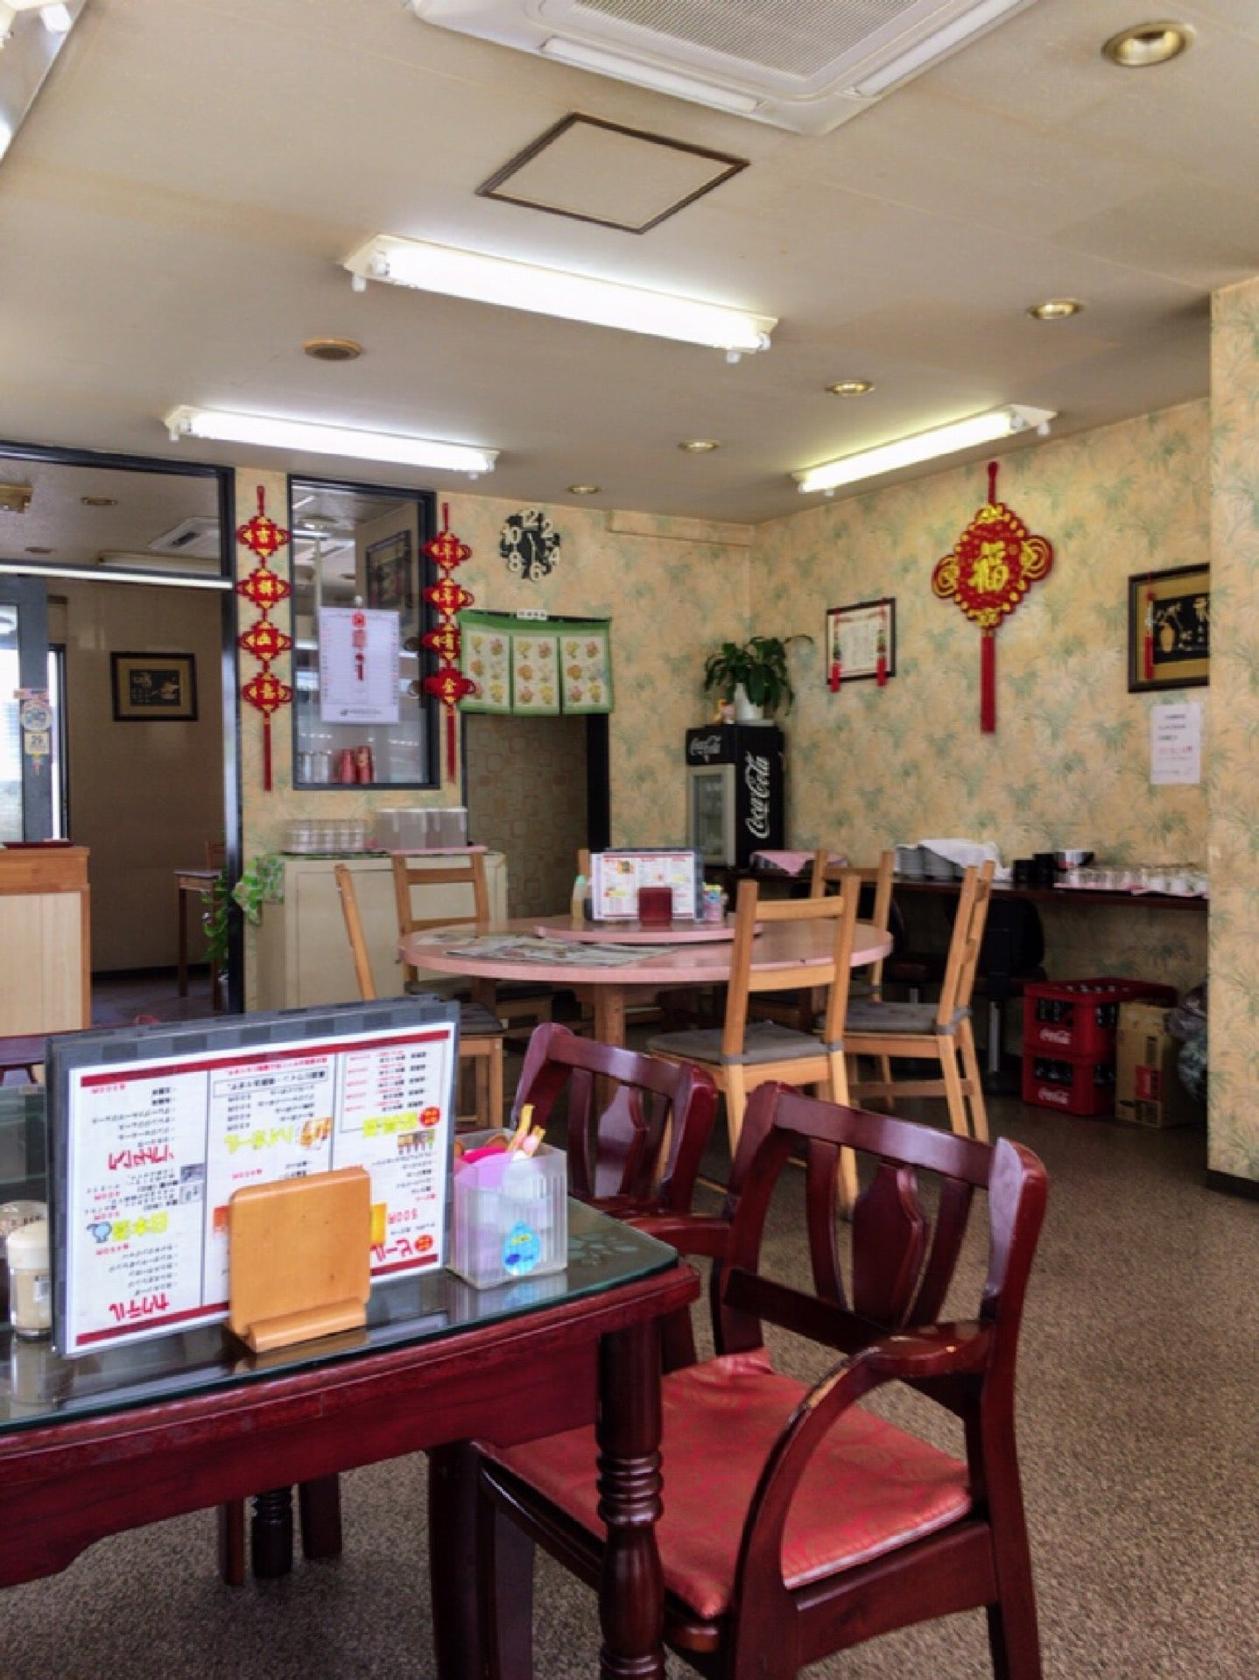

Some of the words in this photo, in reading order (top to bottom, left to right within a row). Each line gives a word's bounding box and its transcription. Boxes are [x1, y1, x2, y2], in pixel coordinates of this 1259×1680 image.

[523, 510, 540, 528] 12
[541, 519, 554, 538] 2
[508, 552, 522, 572] 8
[530, 562, 542, 582] 6
[968, 540, 1009, 593] 福
[745, 751, 770, 839] Coca-Cola
[108, 1293, 170, 1321] カクテル
